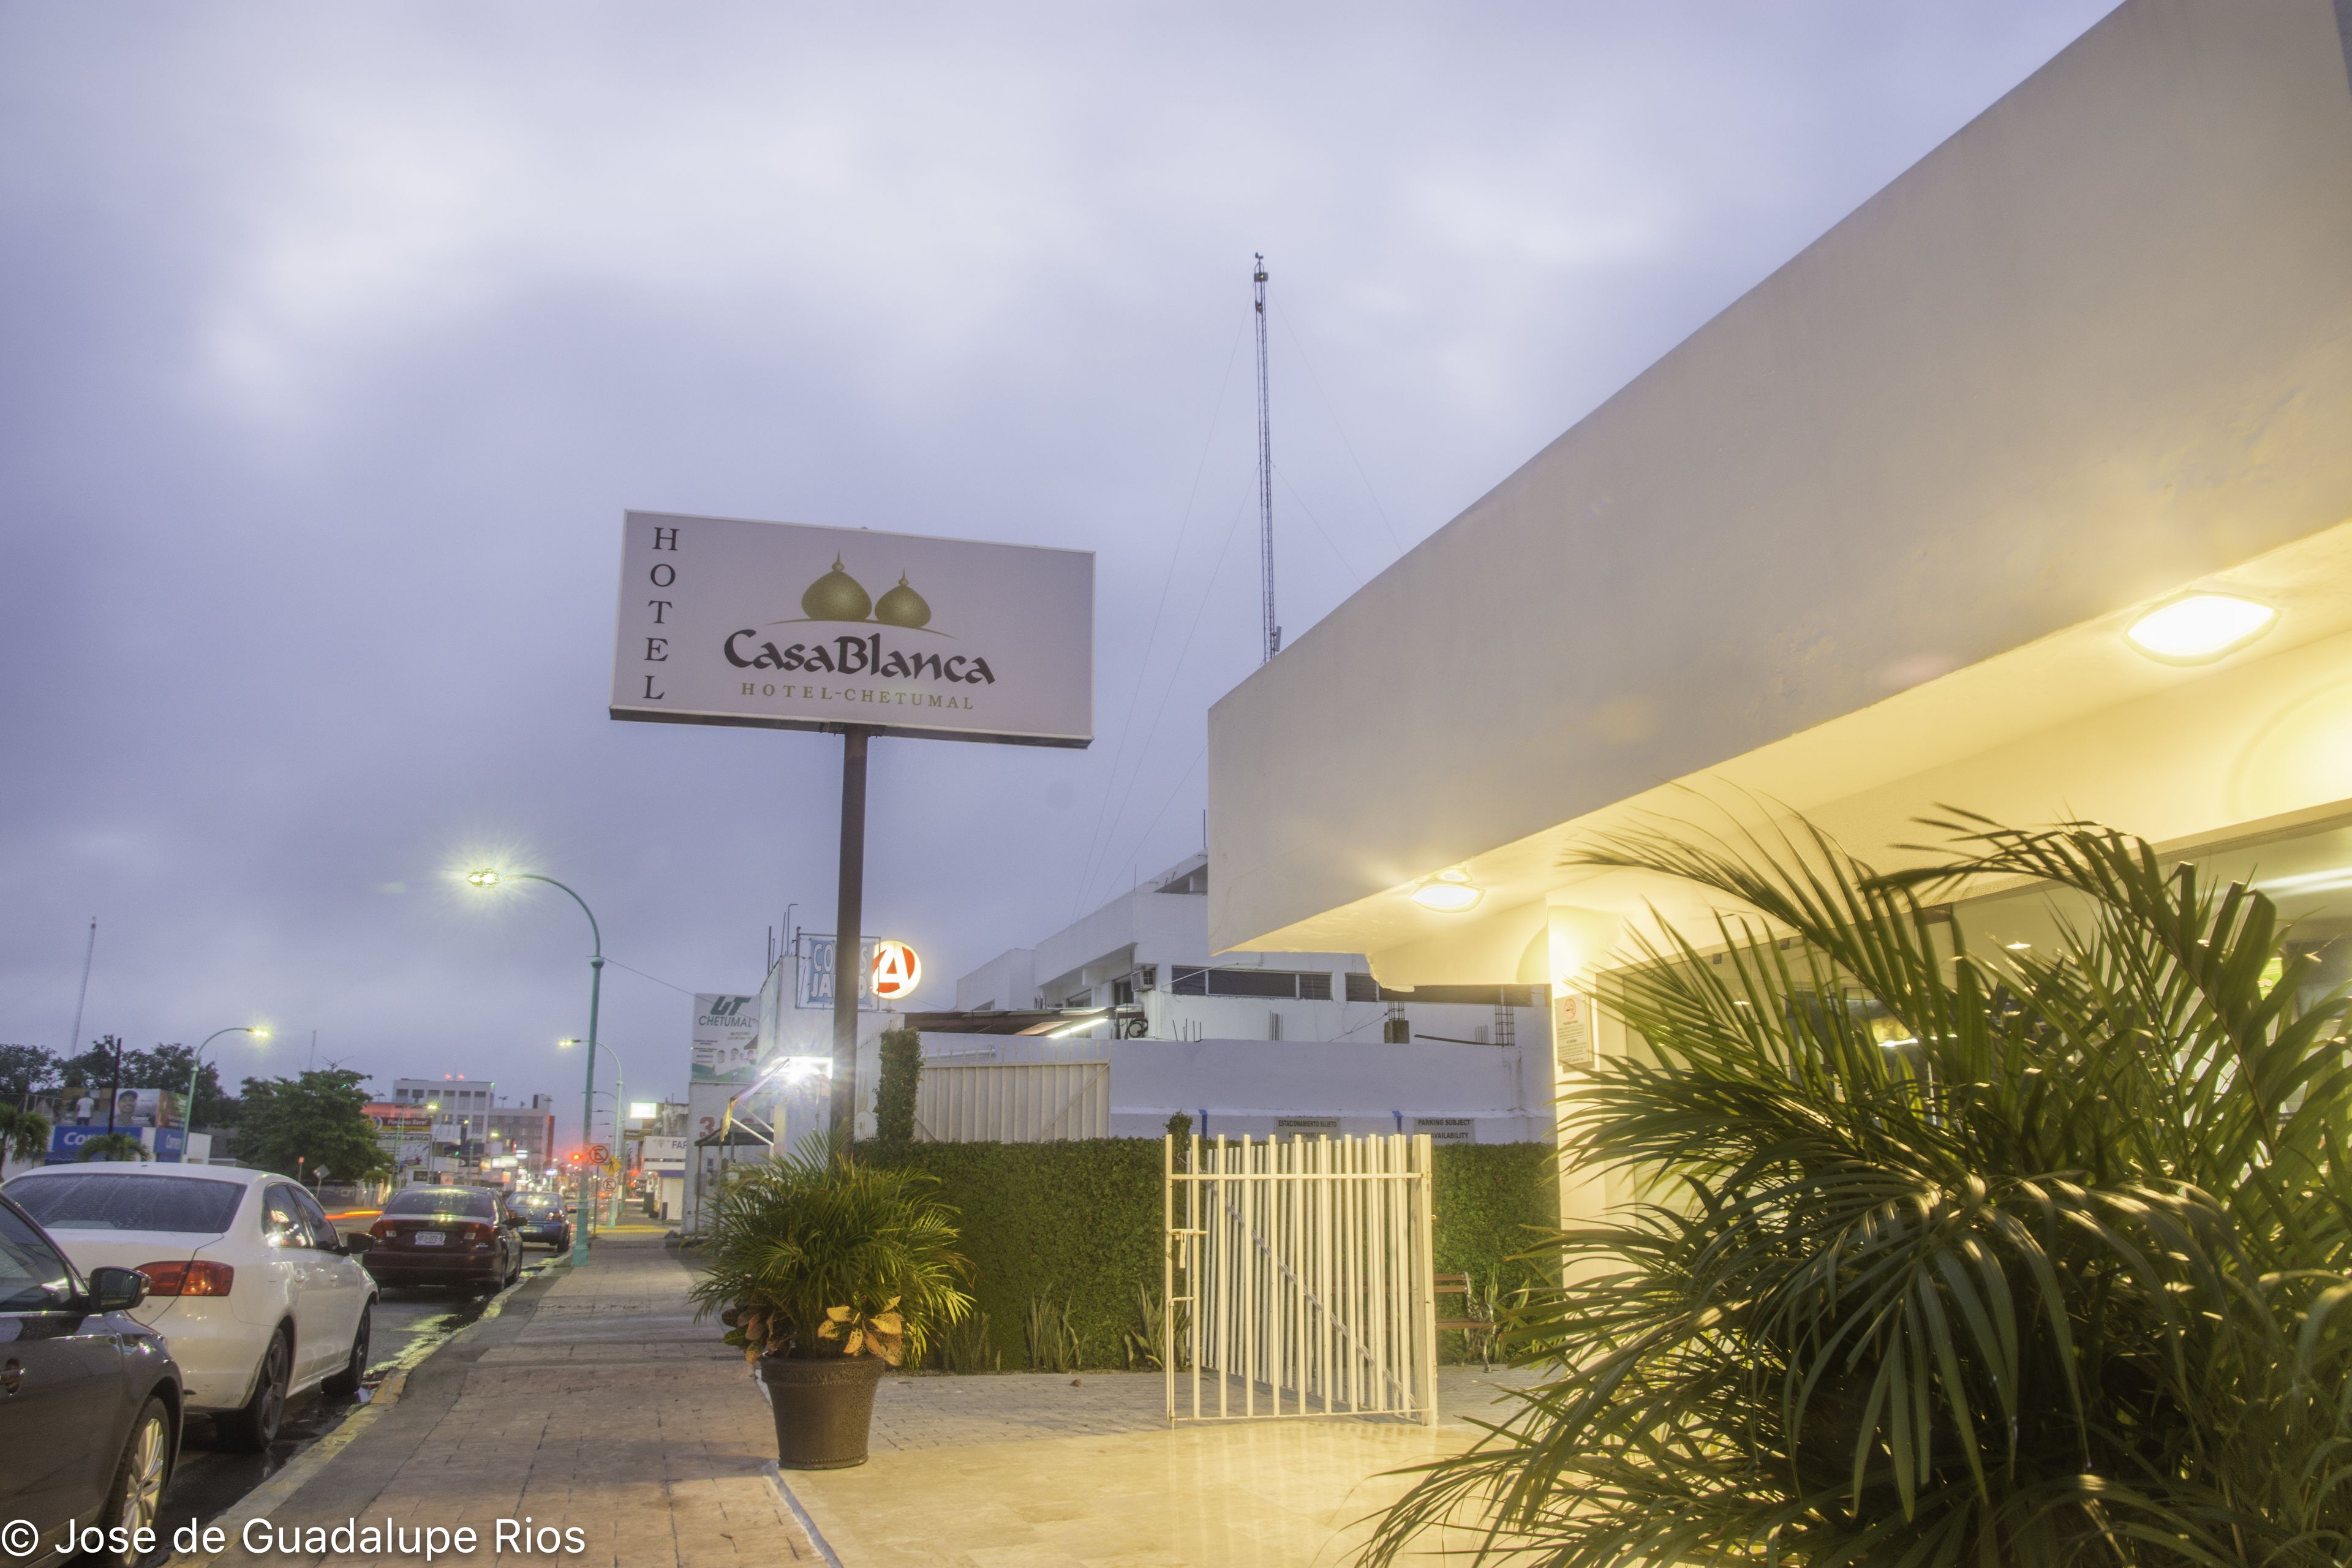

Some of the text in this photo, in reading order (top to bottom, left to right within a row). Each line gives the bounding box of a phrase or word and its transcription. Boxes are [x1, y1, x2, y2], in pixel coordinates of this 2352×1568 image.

[643, 527, 680, 699] HOTEL
[724, 628, 996, 685] CasaBlanca
[741, 682, 974, 709] HOTEL-CHETUMAL
[698, 1015, 753, 1027] CHETUMAL
